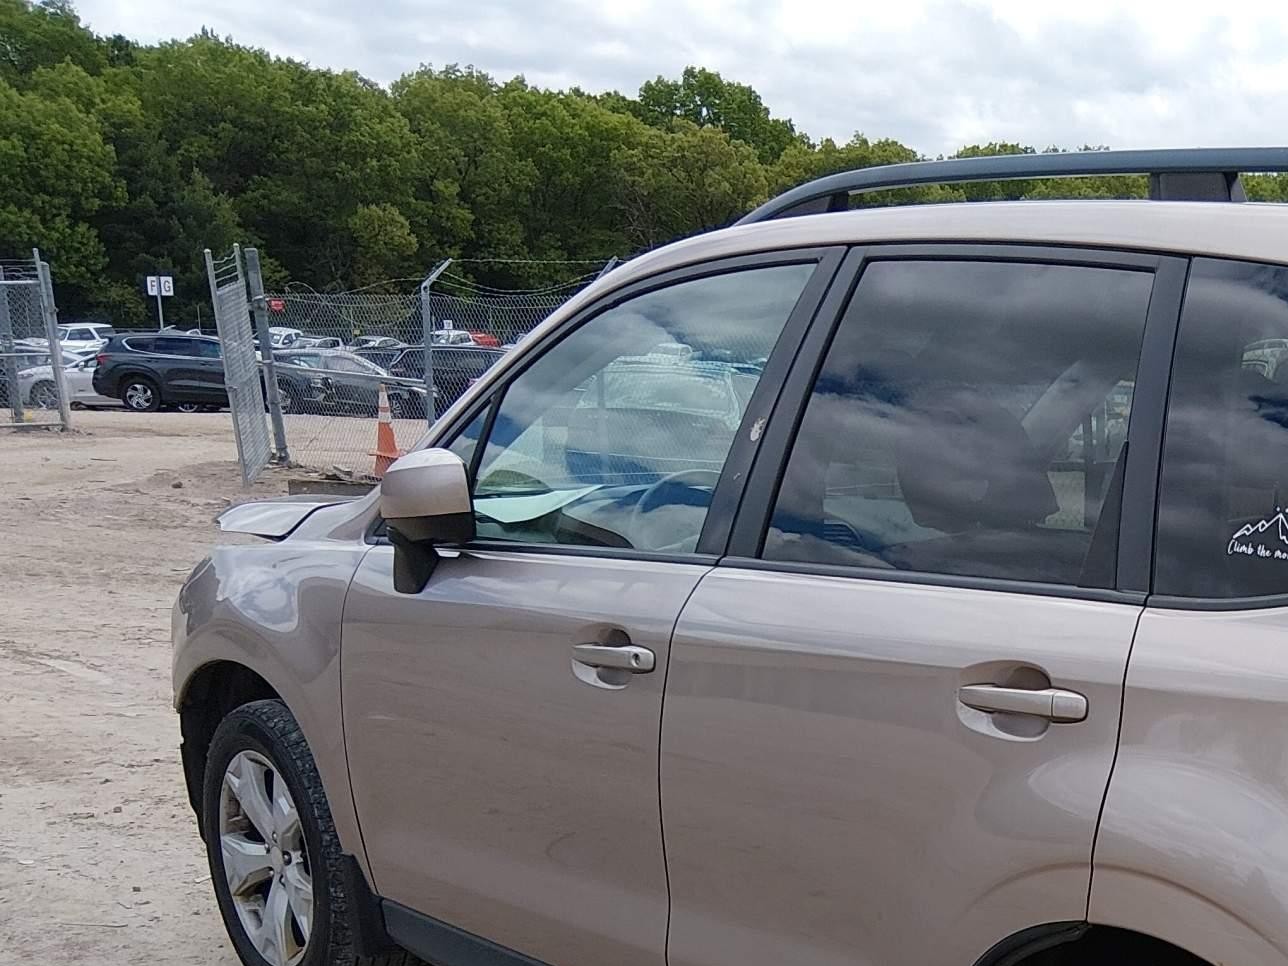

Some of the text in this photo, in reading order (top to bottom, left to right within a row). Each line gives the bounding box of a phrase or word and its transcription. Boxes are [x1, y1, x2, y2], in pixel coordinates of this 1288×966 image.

[163, 280, 171, 292] G
[1228, 539, 1254, 554] Climb
[1257, 544, 1271, 557] the
